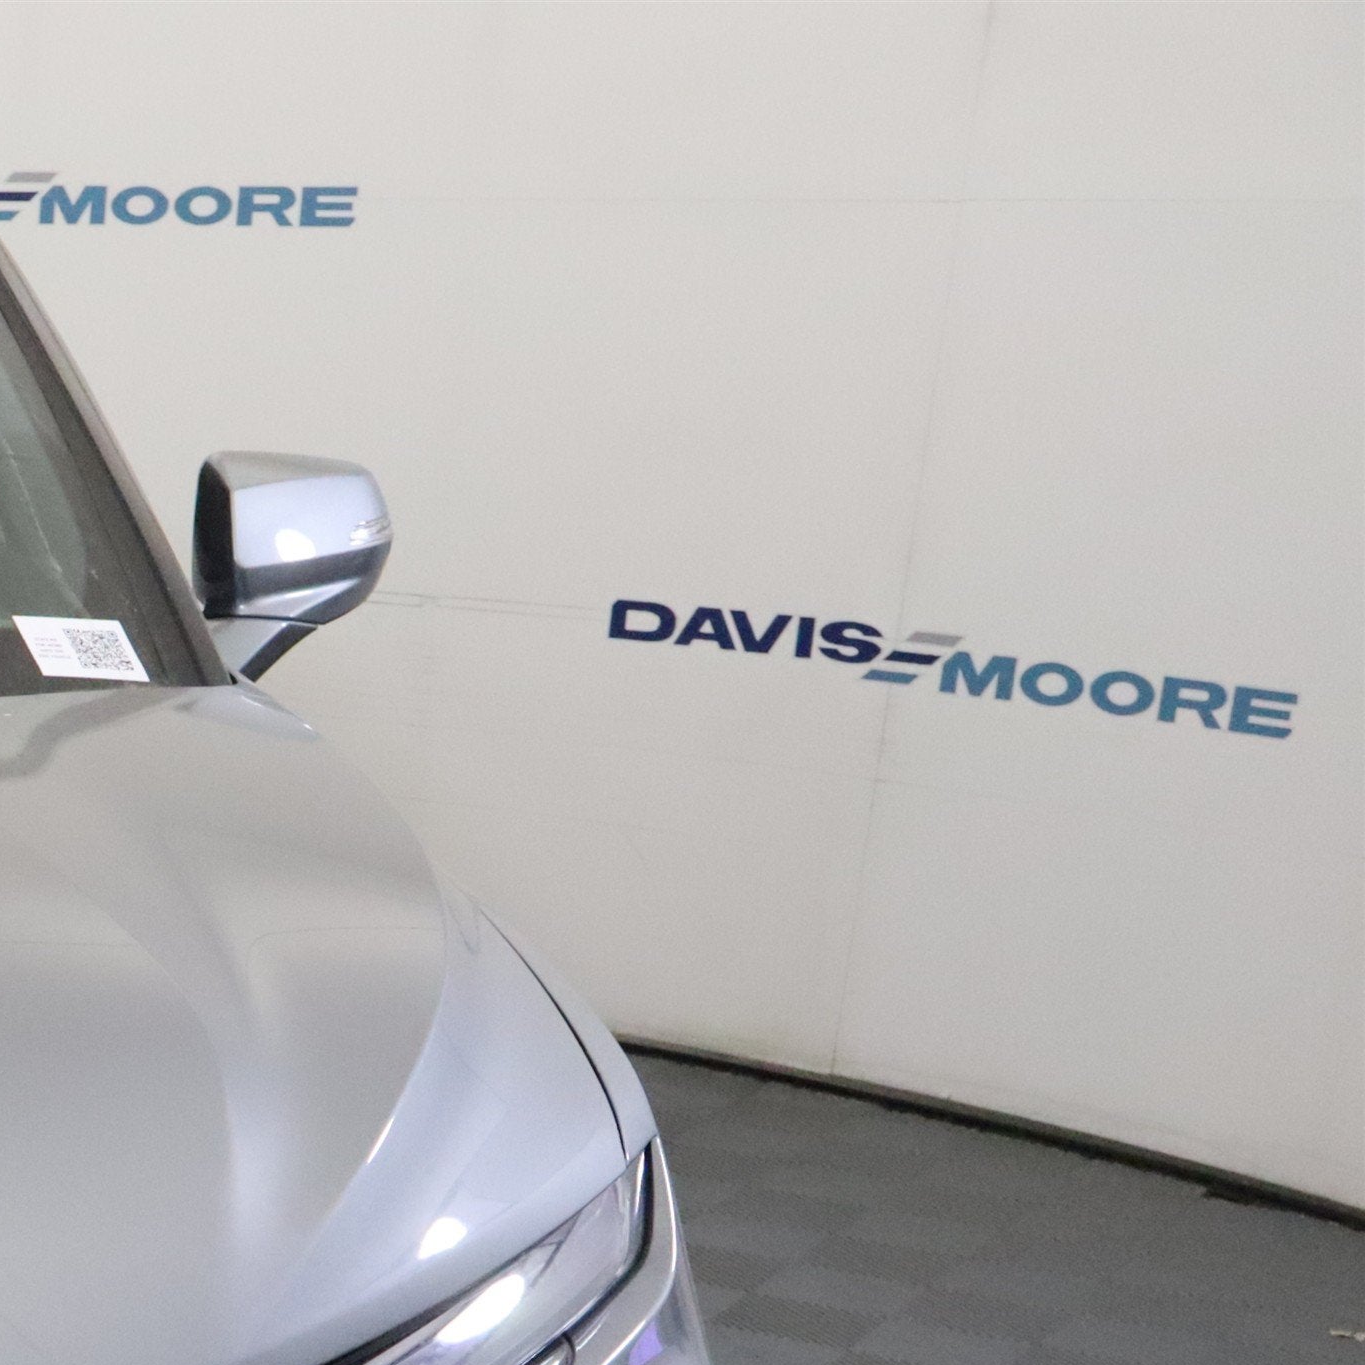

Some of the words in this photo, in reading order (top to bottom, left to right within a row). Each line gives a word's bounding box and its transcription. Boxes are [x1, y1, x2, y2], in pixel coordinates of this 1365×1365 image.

[38, 185, 359, 227] MOORE
[607, 599, 882, 664] DAVIS
[938, 651, 1299, 739] MOORE
